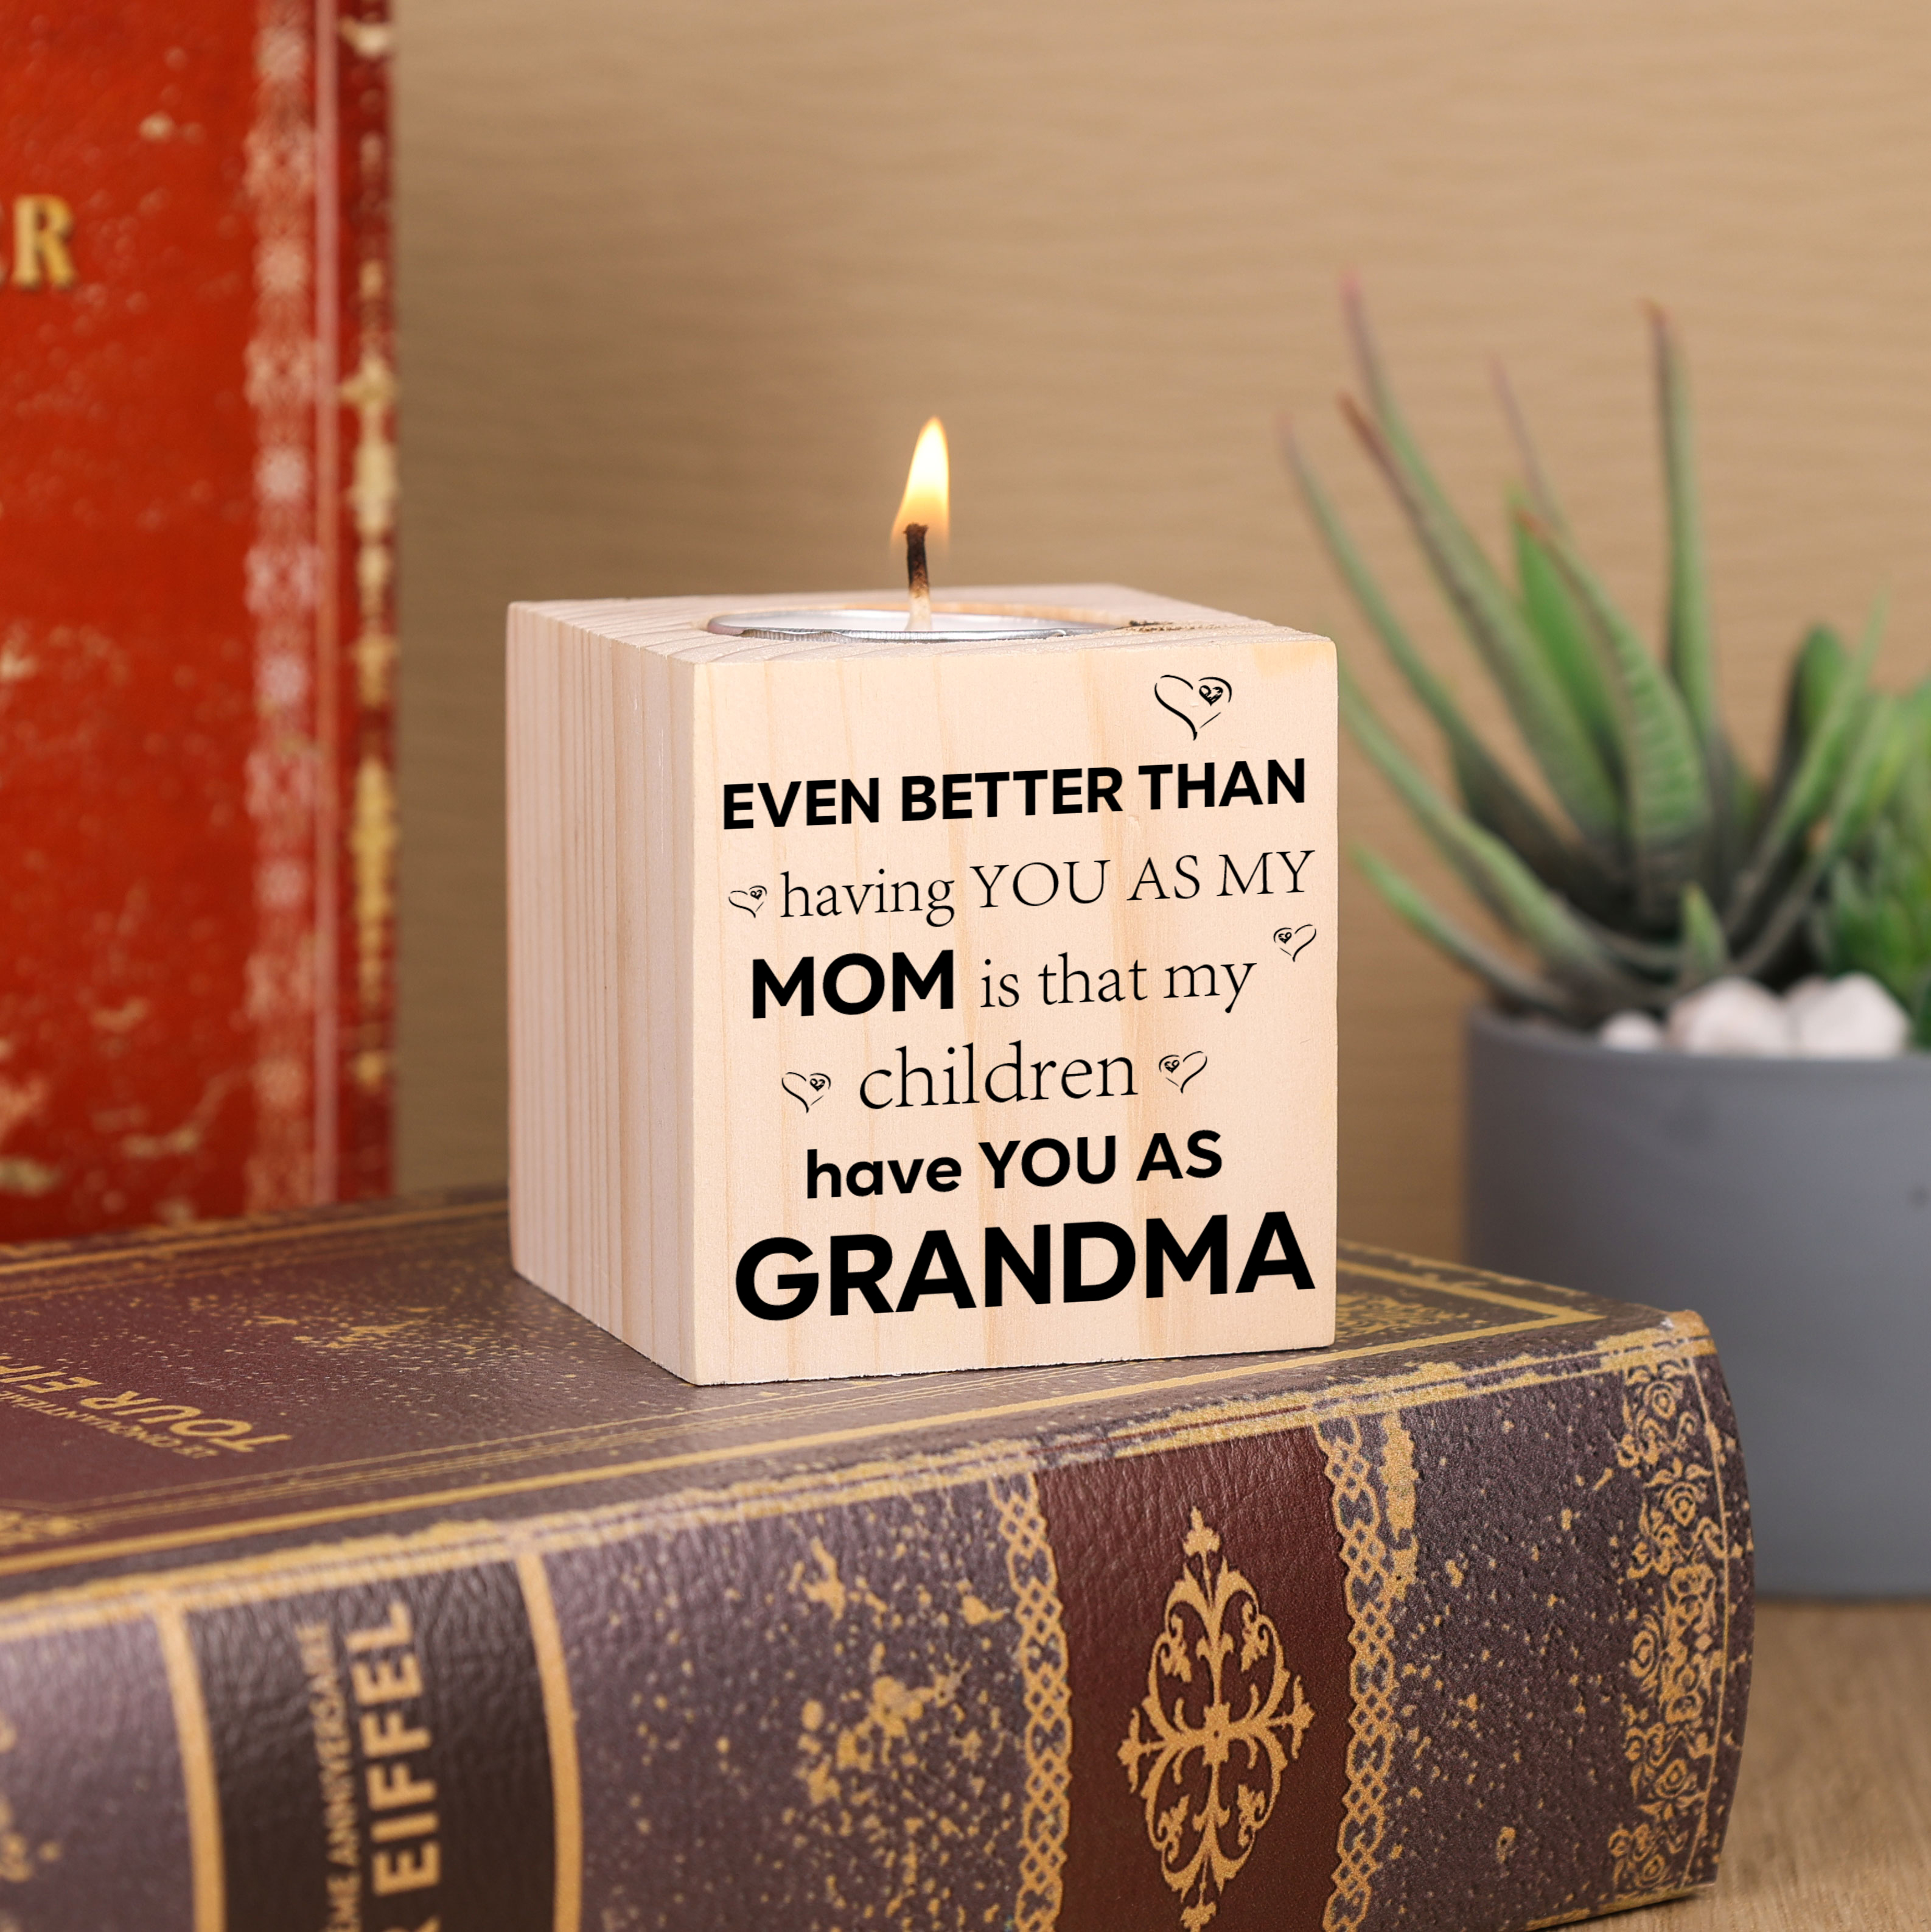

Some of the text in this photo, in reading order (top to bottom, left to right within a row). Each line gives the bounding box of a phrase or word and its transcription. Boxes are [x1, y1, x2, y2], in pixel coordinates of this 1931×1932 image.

[0, 194, 77, 290] R
[724, 758, 1304, 830] EVEN BETTER THAN
[781, 850, 1315, 927] having YOU AS MY
[753, 950, 1257, 1018] MOM is that my
[860, 1040, 1138, 1109] children
[808, 1130, 1222, 1199] have YOU AS
[736, 1211, 1315, 1321] GRANDMA
[0, 1355, 293, 1453] TOUR EI
[344, 1600, 442, 1897] EIFFEL
